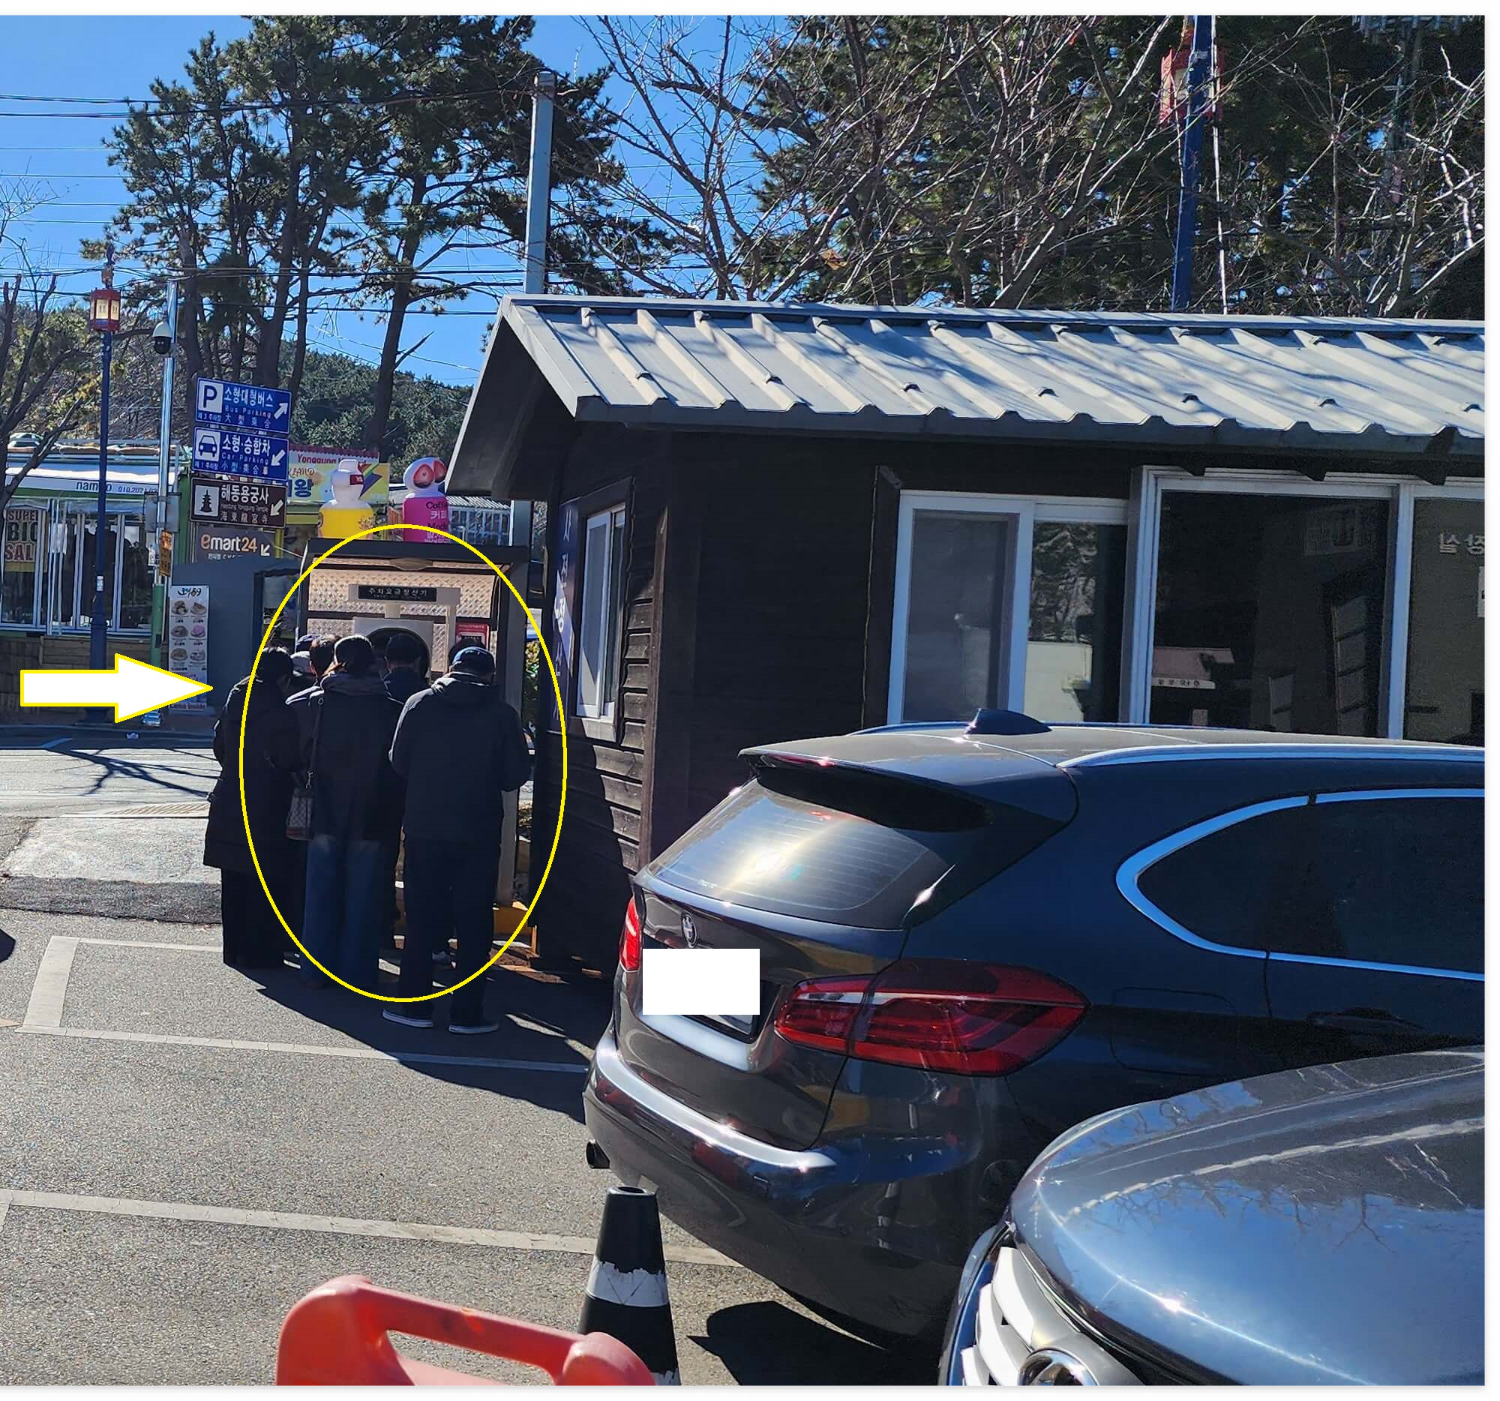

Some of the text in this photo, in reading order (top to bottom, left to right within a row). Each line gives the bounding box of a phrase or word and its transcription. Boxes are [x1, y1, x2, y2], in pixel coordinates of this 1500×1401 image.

[203, 384, 218, 408] P
[223, 386, 274, 408] 소형대형버스
[224, 404, 271, 419] Bus Parking
[222, 434, 270, 457] 소형·승합차
[221, 452, 269, 465] Car Parking
[221, 484, 269, 504] 해동용궁사
[201, 534, 257, 552] emart24
